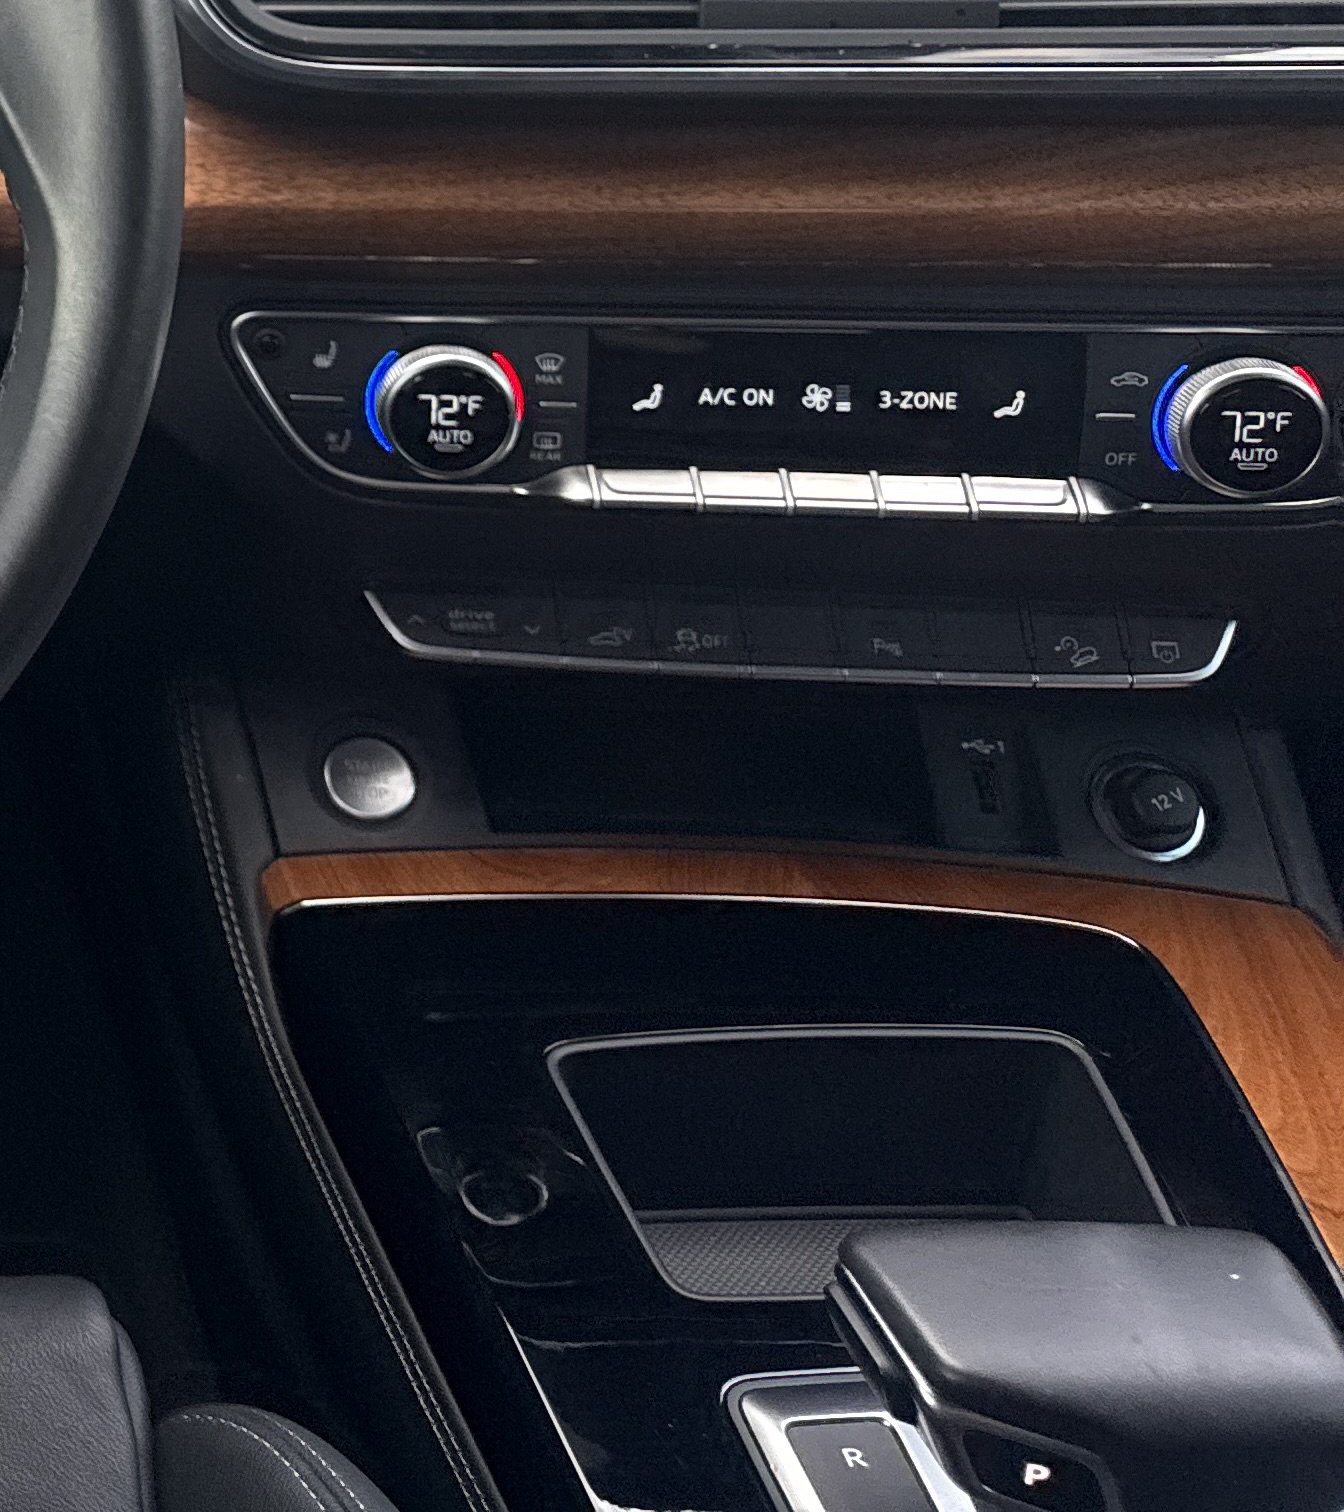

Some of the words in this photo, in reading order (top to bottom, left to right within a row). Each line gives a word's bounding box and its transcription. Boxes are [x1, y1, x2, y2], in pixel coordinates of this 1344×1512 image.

[534, 374, 563, 385] MAX
[697, 387, 736, 406] A/C
[742, 388, 775, 406] ON
[878, 390, 958, 410] 3-ZONE
[426, 429, 475, 445] AUTO
[1104, 452, 1138, 466] OFF
[1229, 447, 1279, 463] AUTO
[1150, 794, 1172, 812] 12
[1170, 787, 1185, 803] V
[841, 1447, 869, 1469] R
[1023, 1462, 1051, 1486] P
